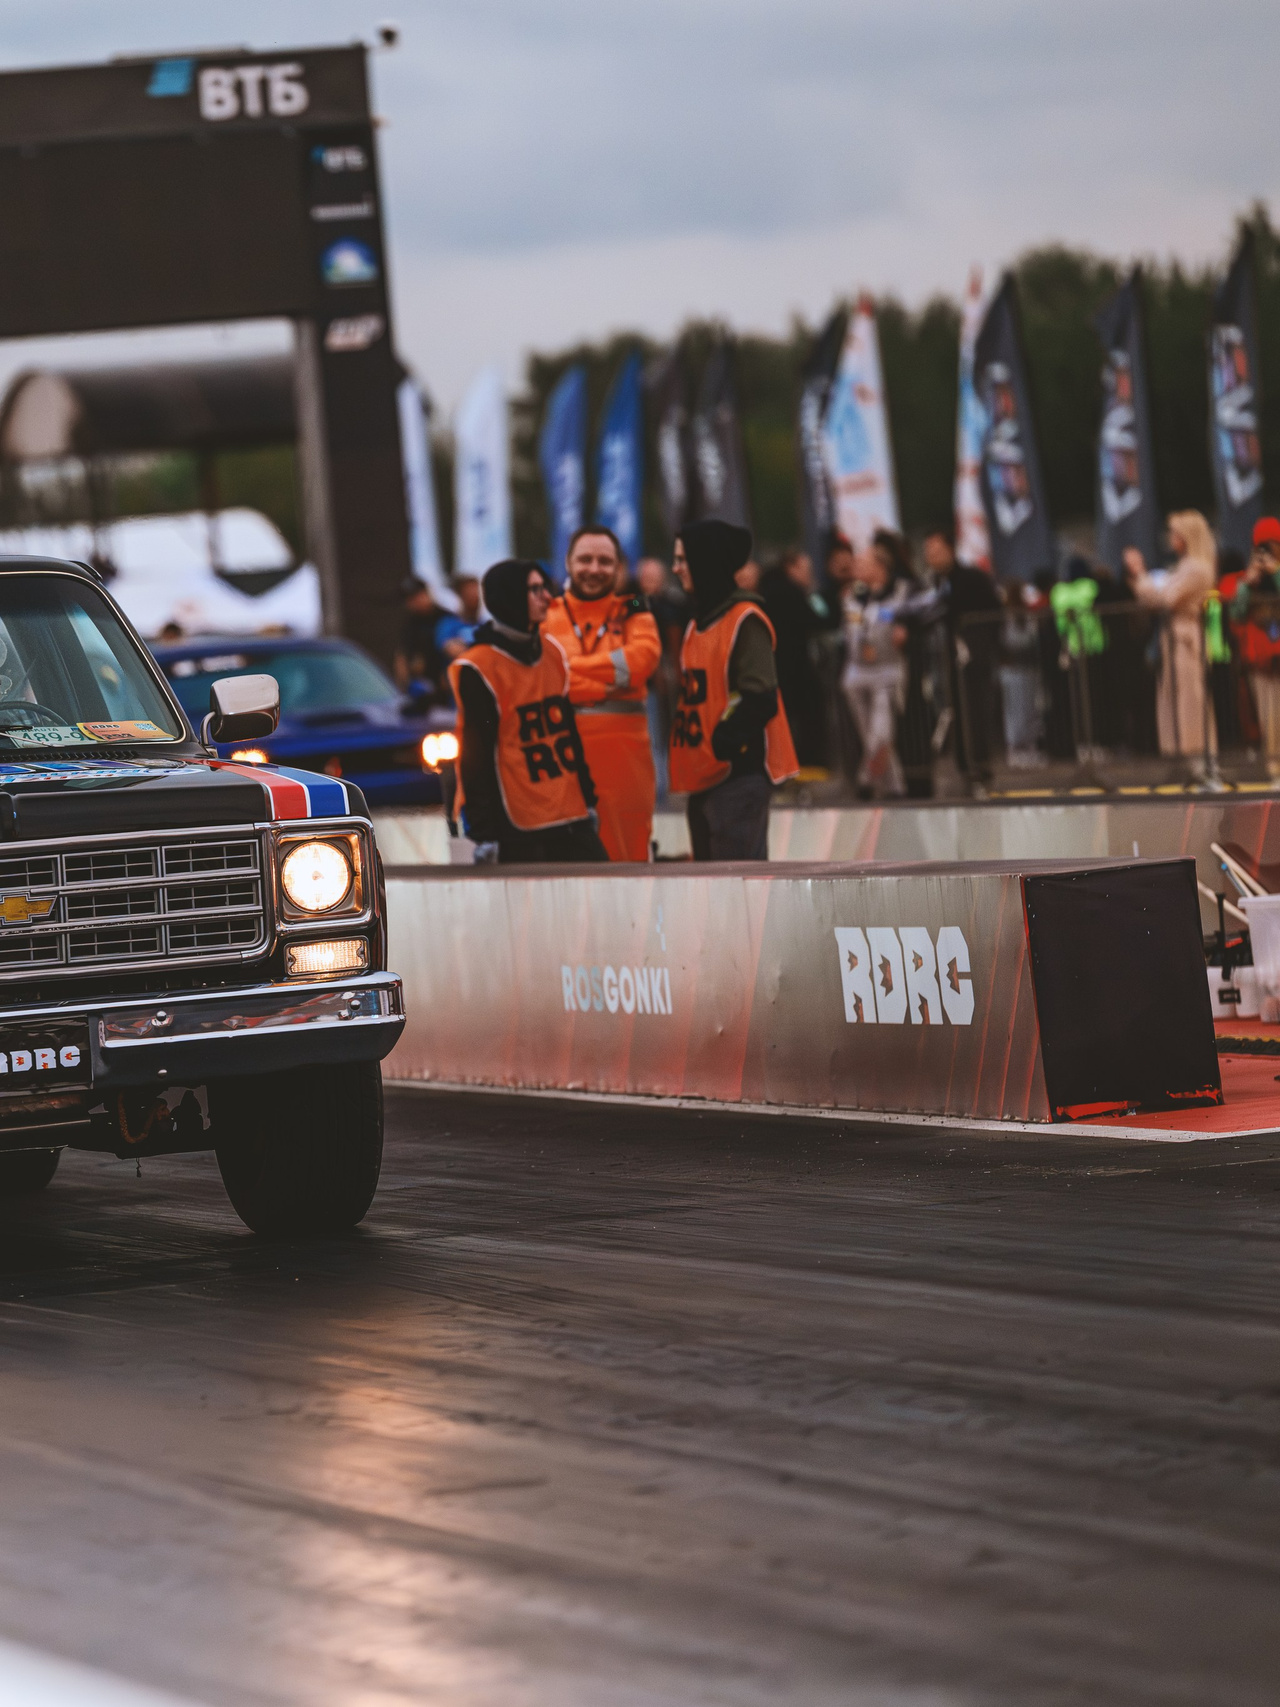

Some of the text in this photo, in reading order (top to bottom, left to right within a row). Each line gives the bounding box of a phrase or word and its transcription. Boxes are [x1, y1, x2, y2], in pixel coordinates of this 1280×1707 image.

[199, 62, 309, 121] ВТБ
[561, 965, 673, 1015] ROSGONKI
[833, 926, 975, 1025] RDRC
